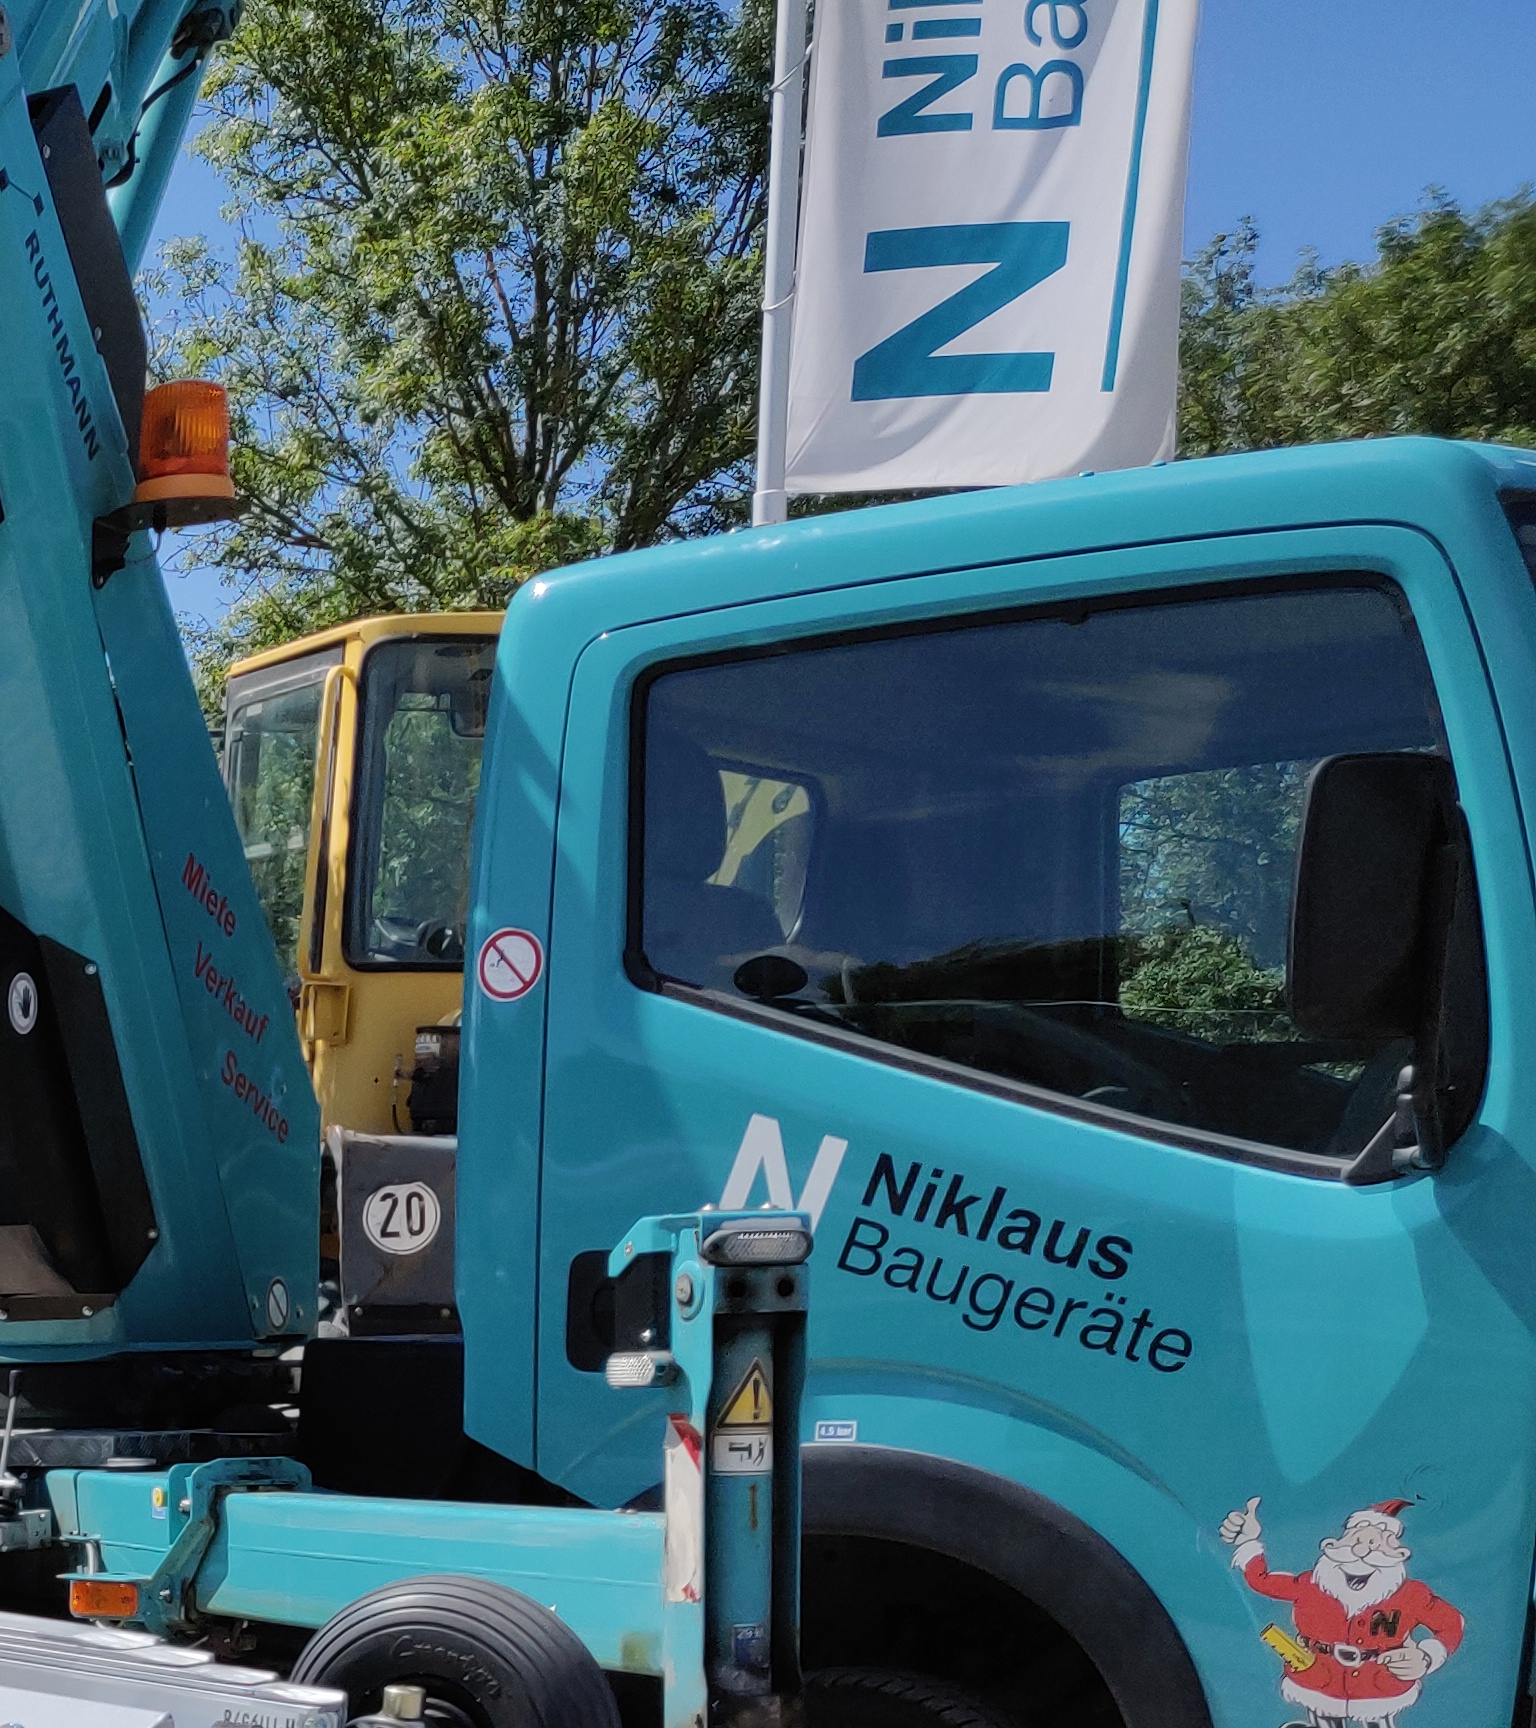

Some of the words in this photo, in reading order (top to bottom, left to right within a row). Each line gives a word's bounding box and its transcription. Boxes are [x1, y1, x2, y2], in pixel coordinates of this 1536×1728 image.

[877, 0, 984, 138] Ni
[25, 229, 100, 461] RUTHMANN
[851, 221, 1070, 401] N
[182, 853, 237, 937] Miete
[193, 941, 269, 1044] Verkauf
[220, 1050, 289, 1143] Service
[378, 1191, 426, 1238] 20
[862, 1152, 1134, 1280] Niklaus
[837, 1217, 1194, 1373] Baugeräte
